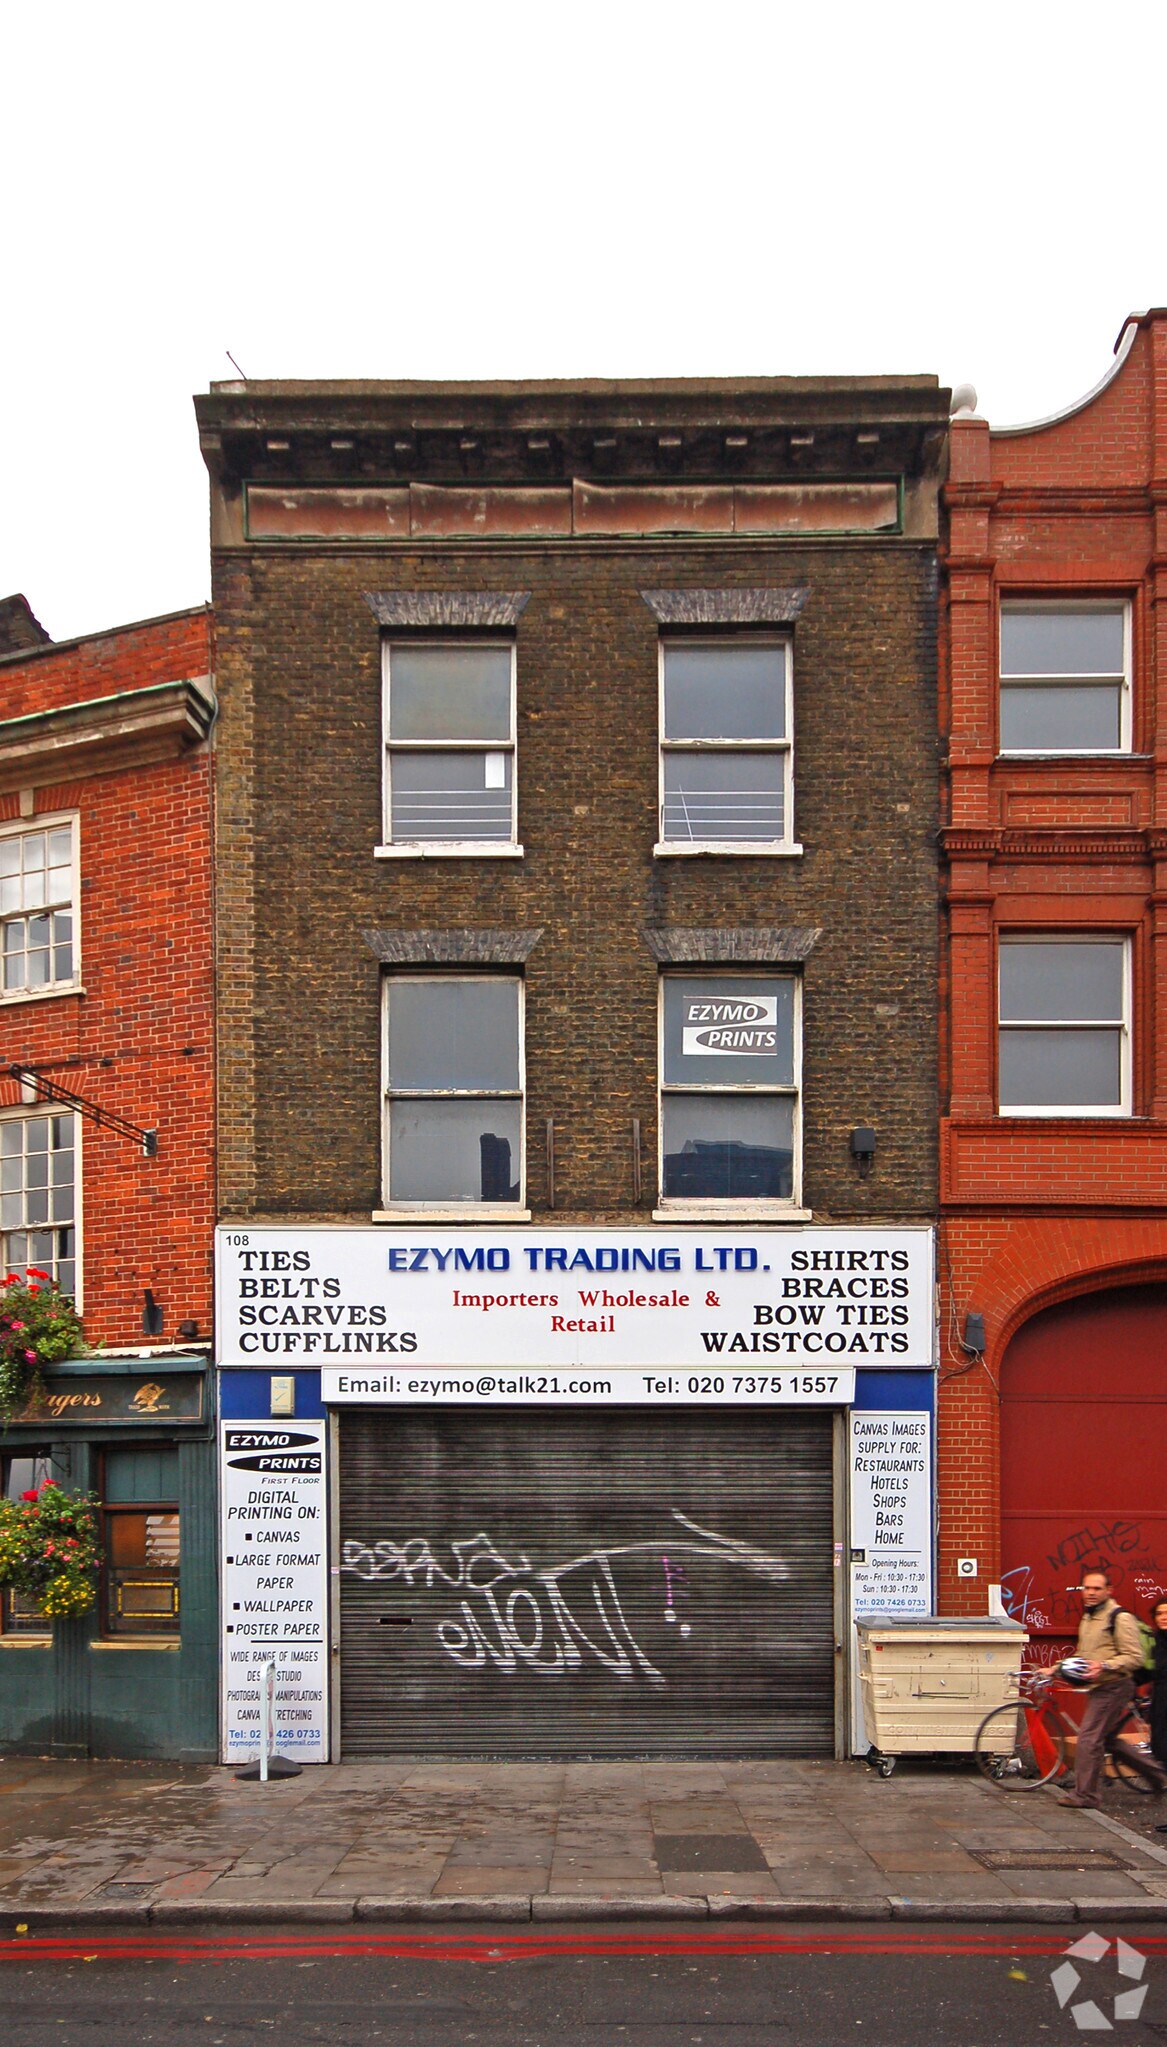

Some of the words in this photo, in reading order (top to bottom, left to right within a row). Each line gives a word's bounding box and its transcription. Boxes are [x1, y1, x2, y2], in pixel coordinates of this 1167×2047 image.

[688, 1005, 759, 1021] EZYMO
[708, 1031, 776, 1047] PRINTS
[225, 1235, 249, 1246] 108
[238, 1251, 311, 1272] TIES
[388, 1248, 510, 1273] EZYMO
[523, 1248, 681, 1273] TRADING
[695, 1247, 771, 1272] LTD.
[791, 1250, 909, 1271] SHIRTS
[239, 1278, 341, 1298] BELTS
[781, 1278, 909, 1299] BRACES
[452, 1290, 559, 1311] Importers
[578, 1290, 690, 1307] Wholesale
[705, 1291, 721, 1307] &
[239, 1305, 387, 1326] SCARVES
[753, 1305, 825, 1326] BOW
[836, 1305, 909, 1326] TIES
[551, 1315, 615, 1333] Retail
[239, 1332, 418, 1353] CUFFLINKS
[700, 1332, 909, 1353] WAISTCOATS
[338, 1375, 402, 1393] Email:
[408, 1375, 612, 1398] ezymo@talk21.com
[643, 1376, 680, 1393] Tel:
[687, 1377, 725, 1394] 020
[733, 1377, 782, 1394] 7375
[790, 1376, 839, 1393] 1557
[44, 1392, 103, 1417] agers
[854, 1421, 888, 1436] CANVAS
[892, 1421, 926, 1436] IMAGES
[229, 1435, 290, 1446] EZYMO
[858, 1442, 896, 1454] SUPPLY
[899, 1442, 922, 1454] FOR:
[259, 1458, 320, 1469] PRINTS
[854, 1458, 925, 1472] RESTAURANTS
[871, 1476, 909, 1490] HOTELS
[248, 1491, 299, 1504] DIGITAL
[873, 1494, 907, 1508] SHOPS
[228, 1507, 292, 1520] PRINTING
[297, 1507, 320, 1519] ON:
[876, 1512, 904, 1526] BARS
[256, 1531, 300, 1543] CANVAS
[874, 1530, 904, 1544] HOME
[235, 1554, 271, 1566] LARGE
[276, 1554, 321, 1566] FORMAT
[872, 1559, 898, 1569] Opening
[256, 1577, 294, 1589] PAPER
[855, 1573, 868, 1581] Mon
[888, 1573, 904, 1581] 10:30
[910, 1573, 926, 1581] 17:30
[862, 1585, 875, 1593] Sun
[880, 1585, 896, 1593] 10:30
[902, 1585, 918, 1593] 17:30
[244, 1600, 313, 1612] WALLPAPER
[236, 1624, 278, 1635] POSTER
[283, 1624, 320, 1635] PAPER
[230, 1651, 250, 1662] WIDE
[252, 1651, 276, 1661] RANGE
[278, 1651, 288, 1662] OF
[291, 1651, 319, 1662] IMAGES
[276, 1670, 302, 1682] STUDIO
[237, 1709, 261, 1721] CANVA
[275, 1709, 312, 1721] TRETCHING
[229, 1729, 247, 1738] Tel:
[249, 1729, 262, 1738] 02
[275, 1729, 294, 1738] 426
[297, 1729, 320, 1738] 0733
